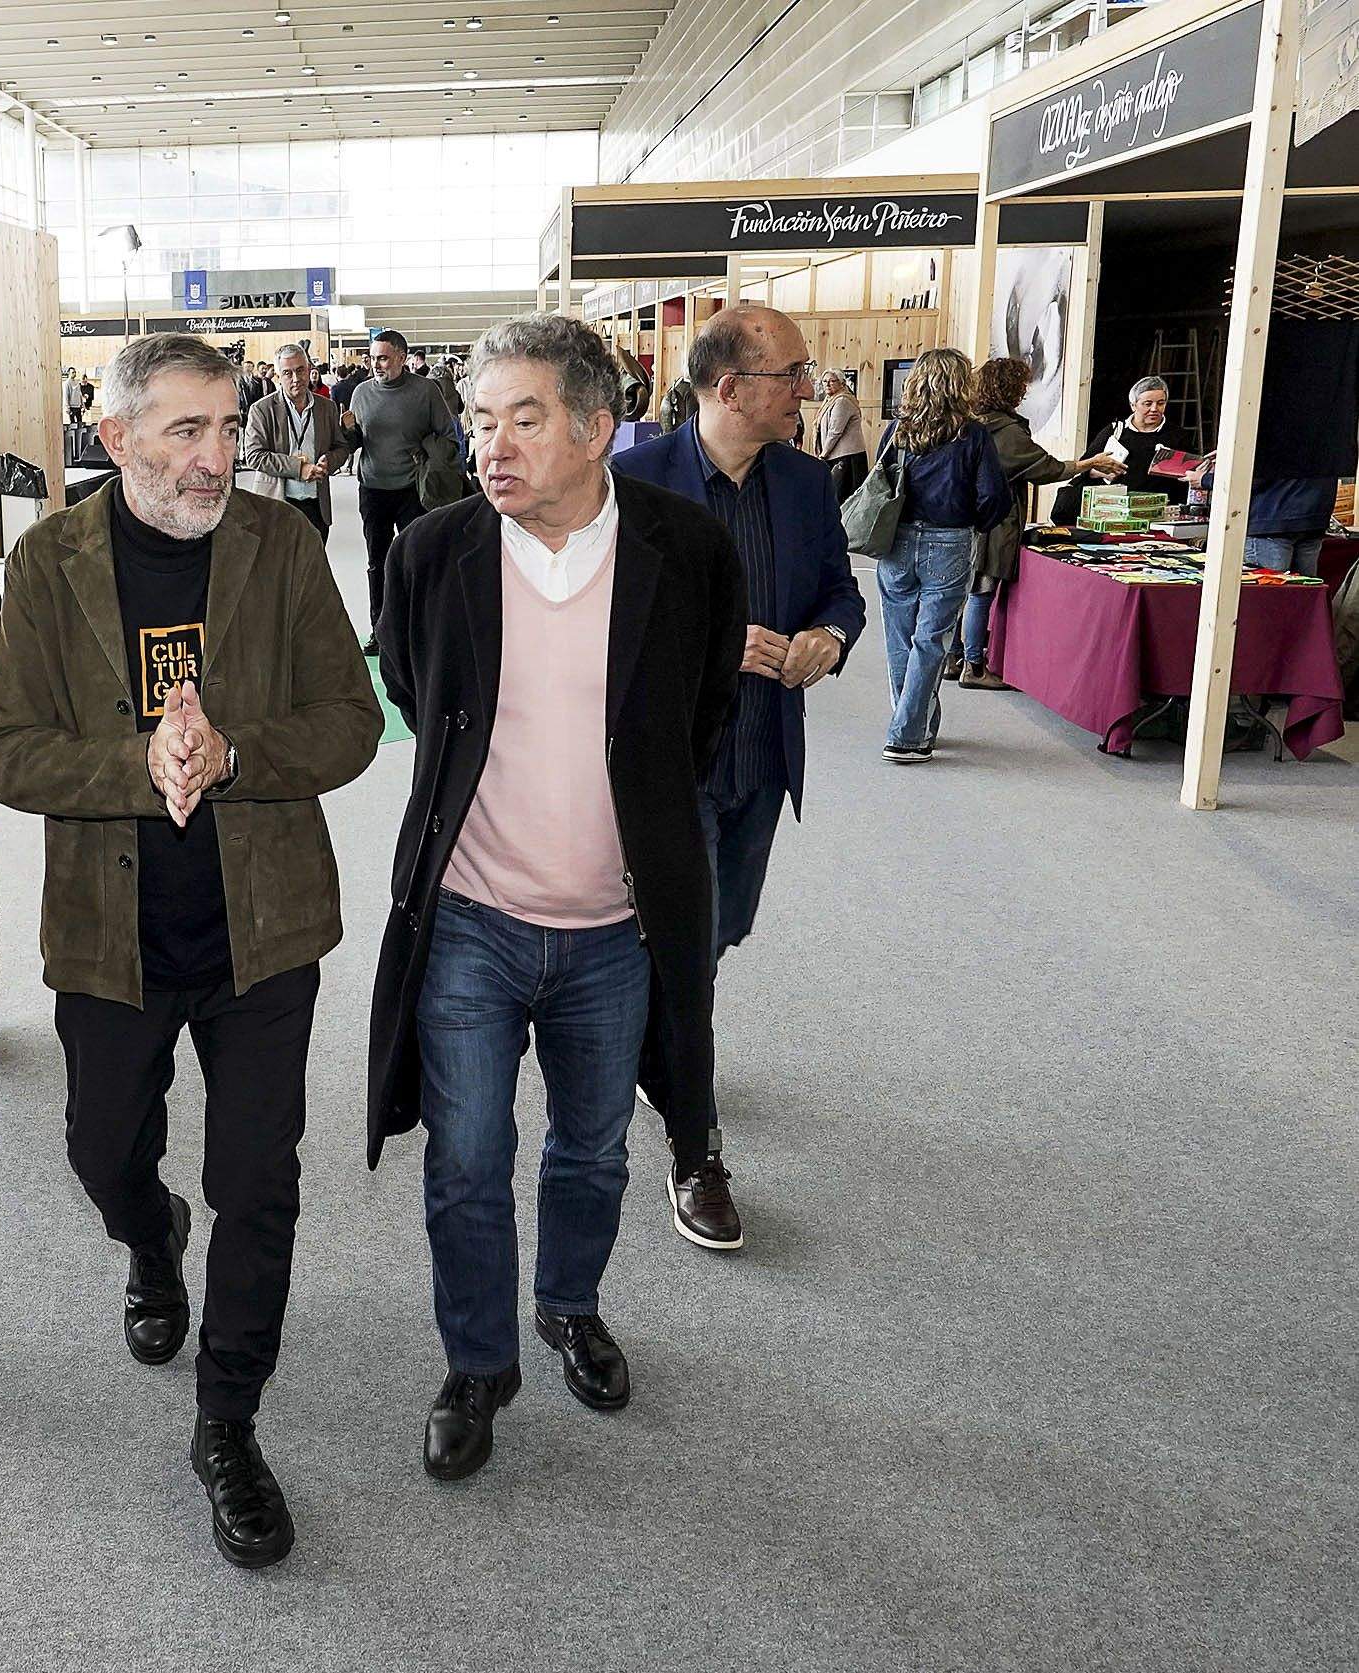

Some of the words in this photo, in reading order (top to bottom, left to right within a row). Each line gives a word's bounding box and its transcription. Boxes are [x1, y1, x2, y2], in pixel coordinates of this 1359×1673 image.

[1093, 79, 1134, 142] deseño
[1128, 50, 1185, 146] galego
[725, 200, 825, 239] Fundación
[822, 201, 873, 243] Xoán
[871, 201, 963, 237] Piñeiro
[151, 641, 195, 662] CUL
[152, 659, 198, 681] TUR
